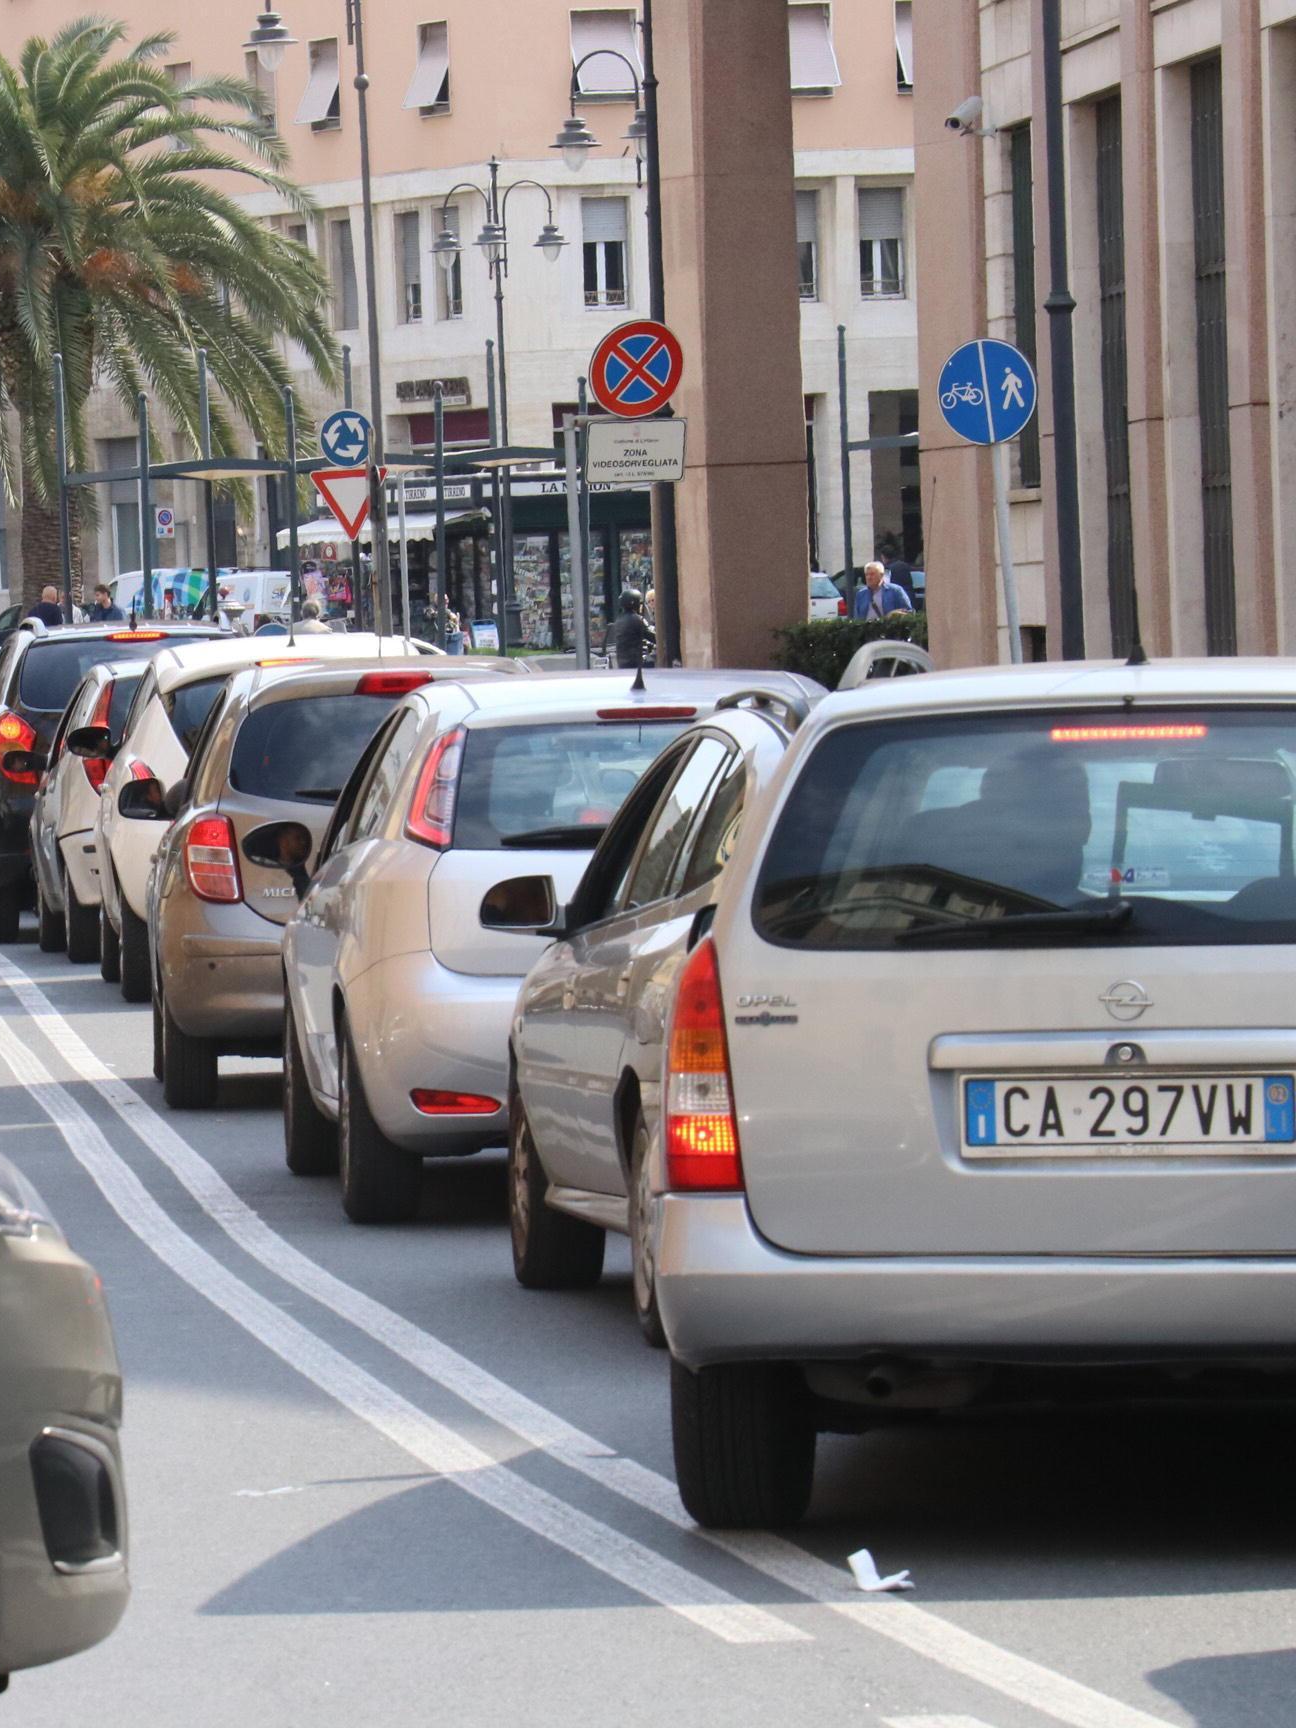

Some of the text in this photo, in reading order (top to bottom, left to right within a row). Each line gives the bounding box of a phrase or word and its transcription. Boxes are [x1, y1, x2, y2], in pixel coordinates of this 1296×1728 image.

[623, 448, 648, 457] ZONA
[592, 458, 679, 468] VIDEOSORVEGLIATA
[541, 482, 558, 493] LA
[736, 995, 797, 1007] OPEL
[1003, 1085, 1065, 1138] CA
[1089, 1083, 1254, 1138] 297VW
